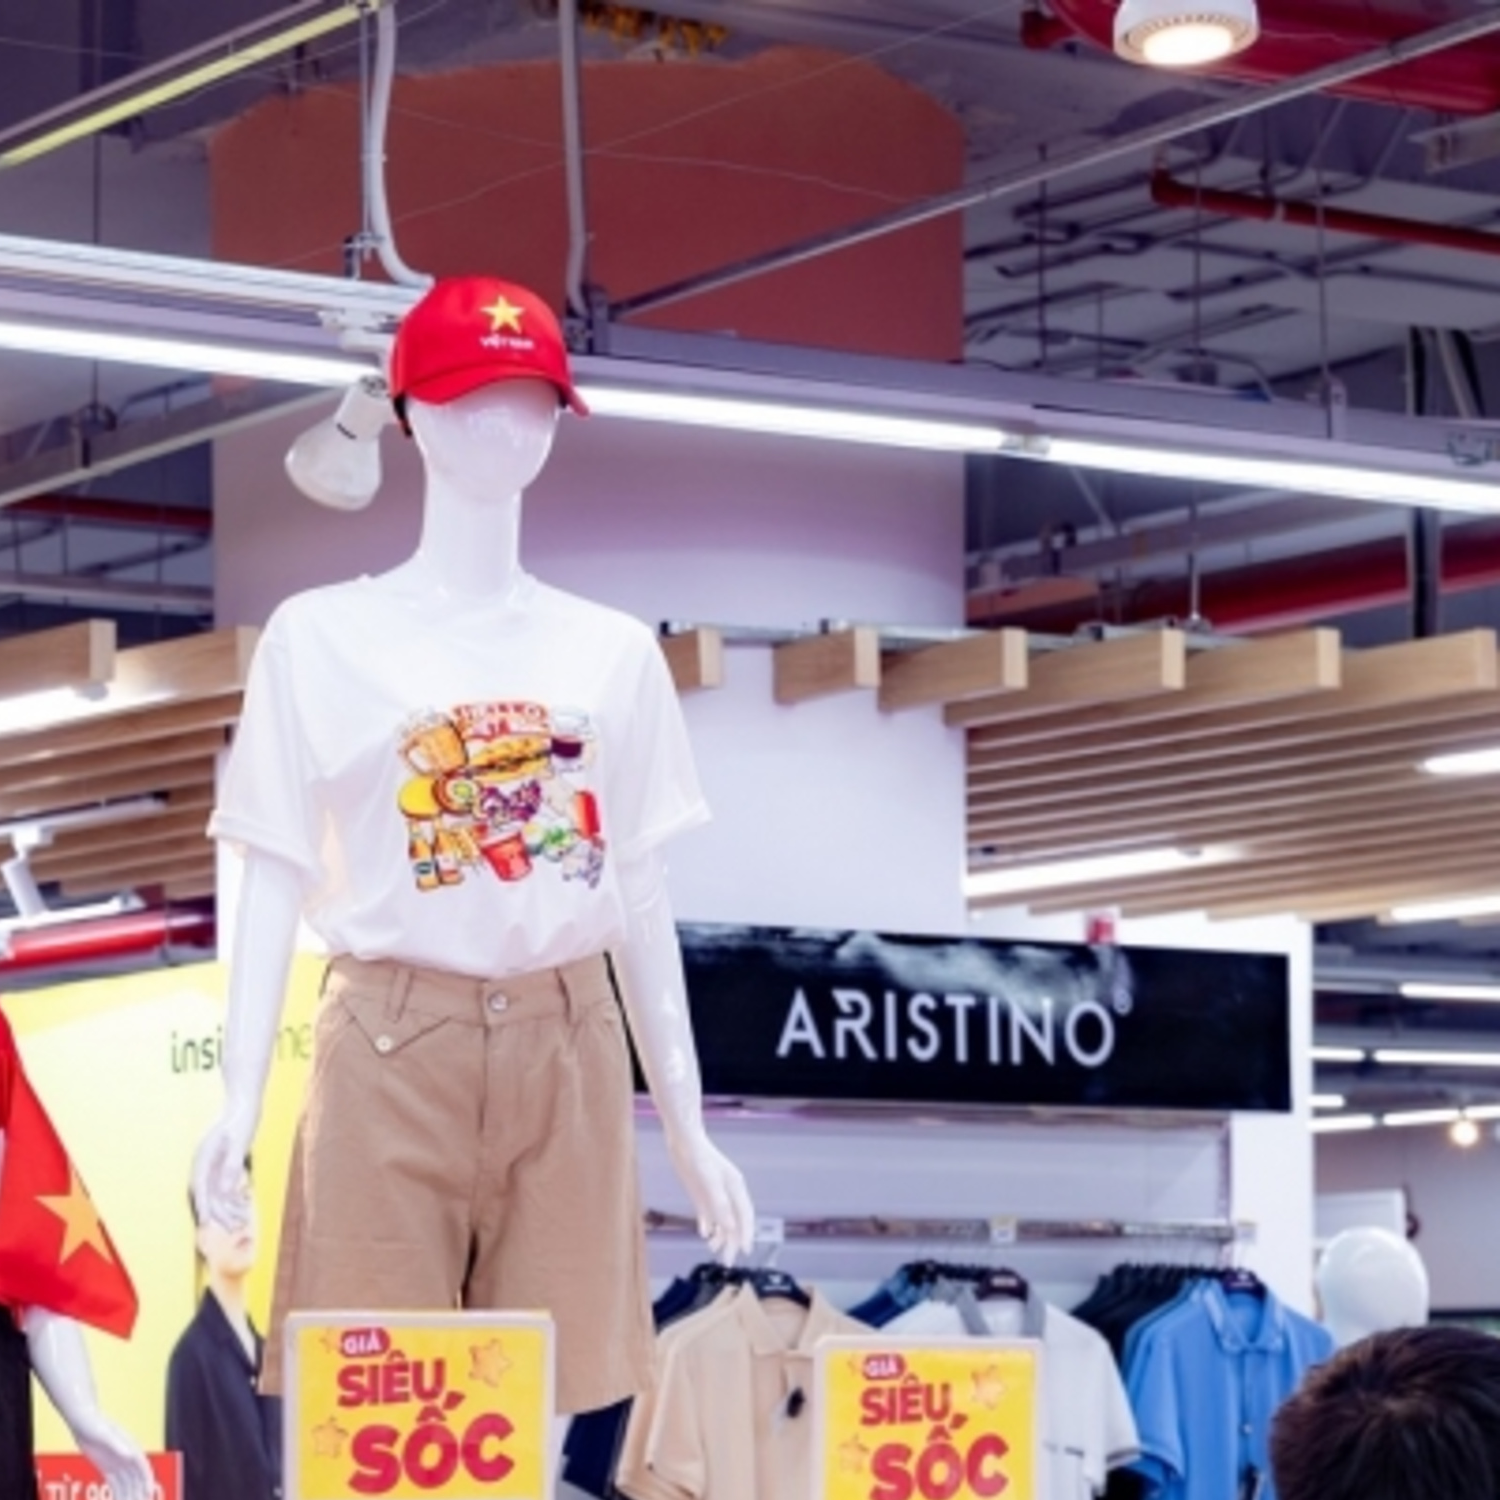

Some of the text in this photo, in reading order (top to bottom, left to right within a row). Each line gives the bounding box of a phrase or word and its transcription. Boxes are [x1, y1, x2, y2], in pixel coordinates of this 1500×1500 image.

[776, 986, 1115, 1067] ARISTINO
[337, 1349, 445, 1408] SIÊU
[860, 1372, 951, 1427] SIÊU
[348, 1390, 515, 1495] SỐC
